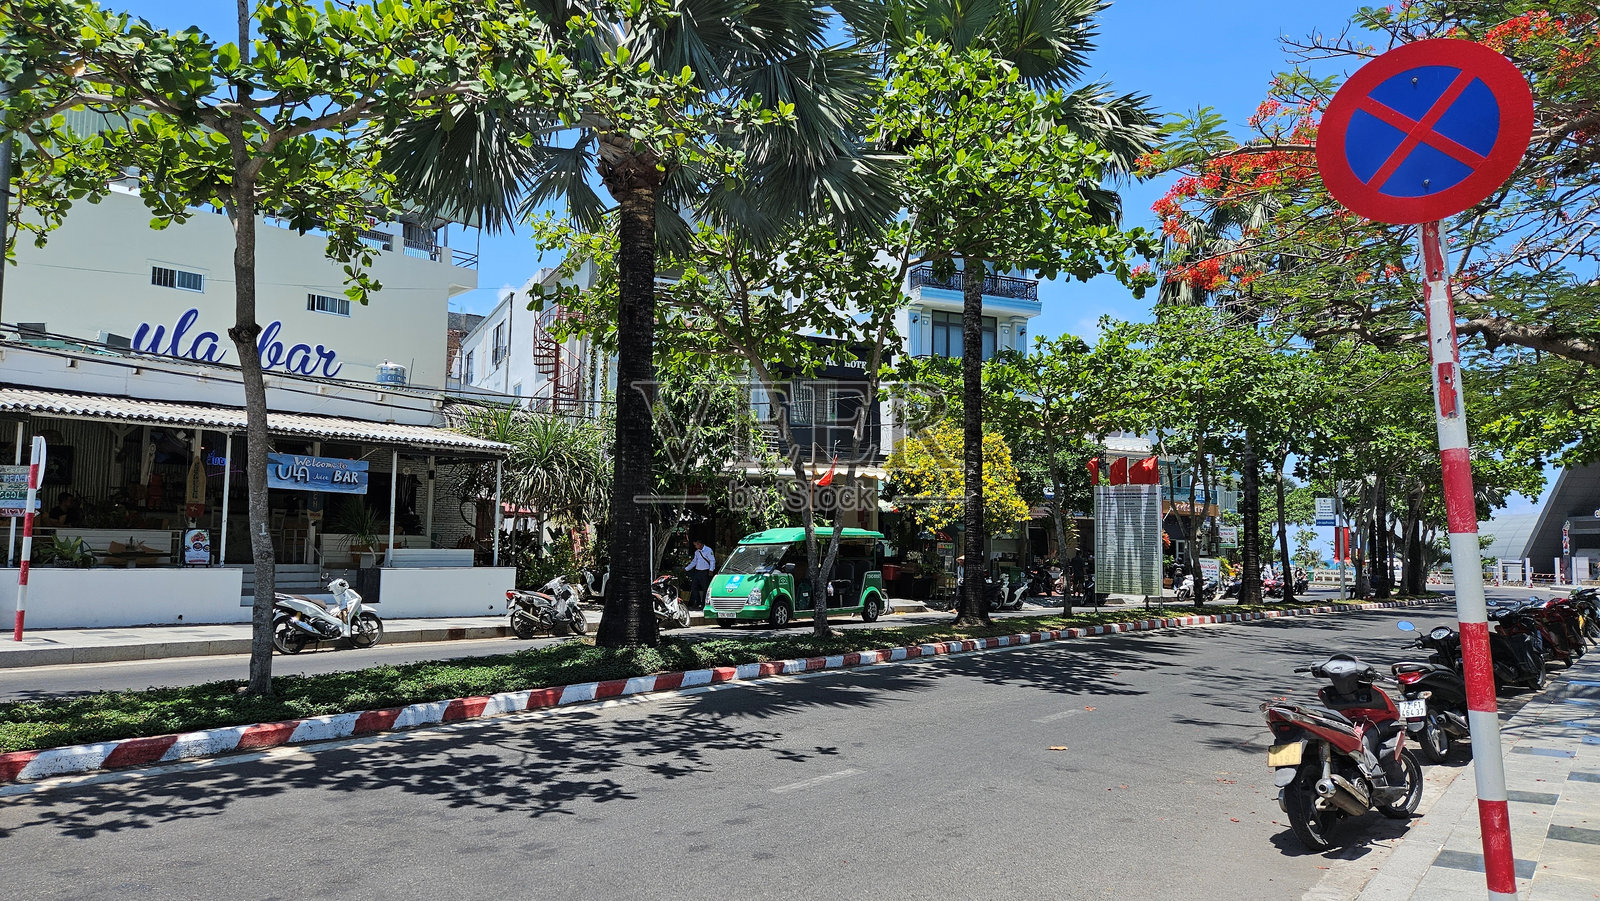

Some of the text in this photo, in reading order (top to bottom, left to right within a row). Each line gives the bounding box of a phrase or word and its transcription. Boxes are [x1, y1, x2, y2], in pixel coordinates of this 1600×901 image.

[131, 307, 343, 377] ula bar
[294, 457, 337, 469] Welcome
[277, 464, 310, 481] ULA
[333, 470, 359, 483] BAR
